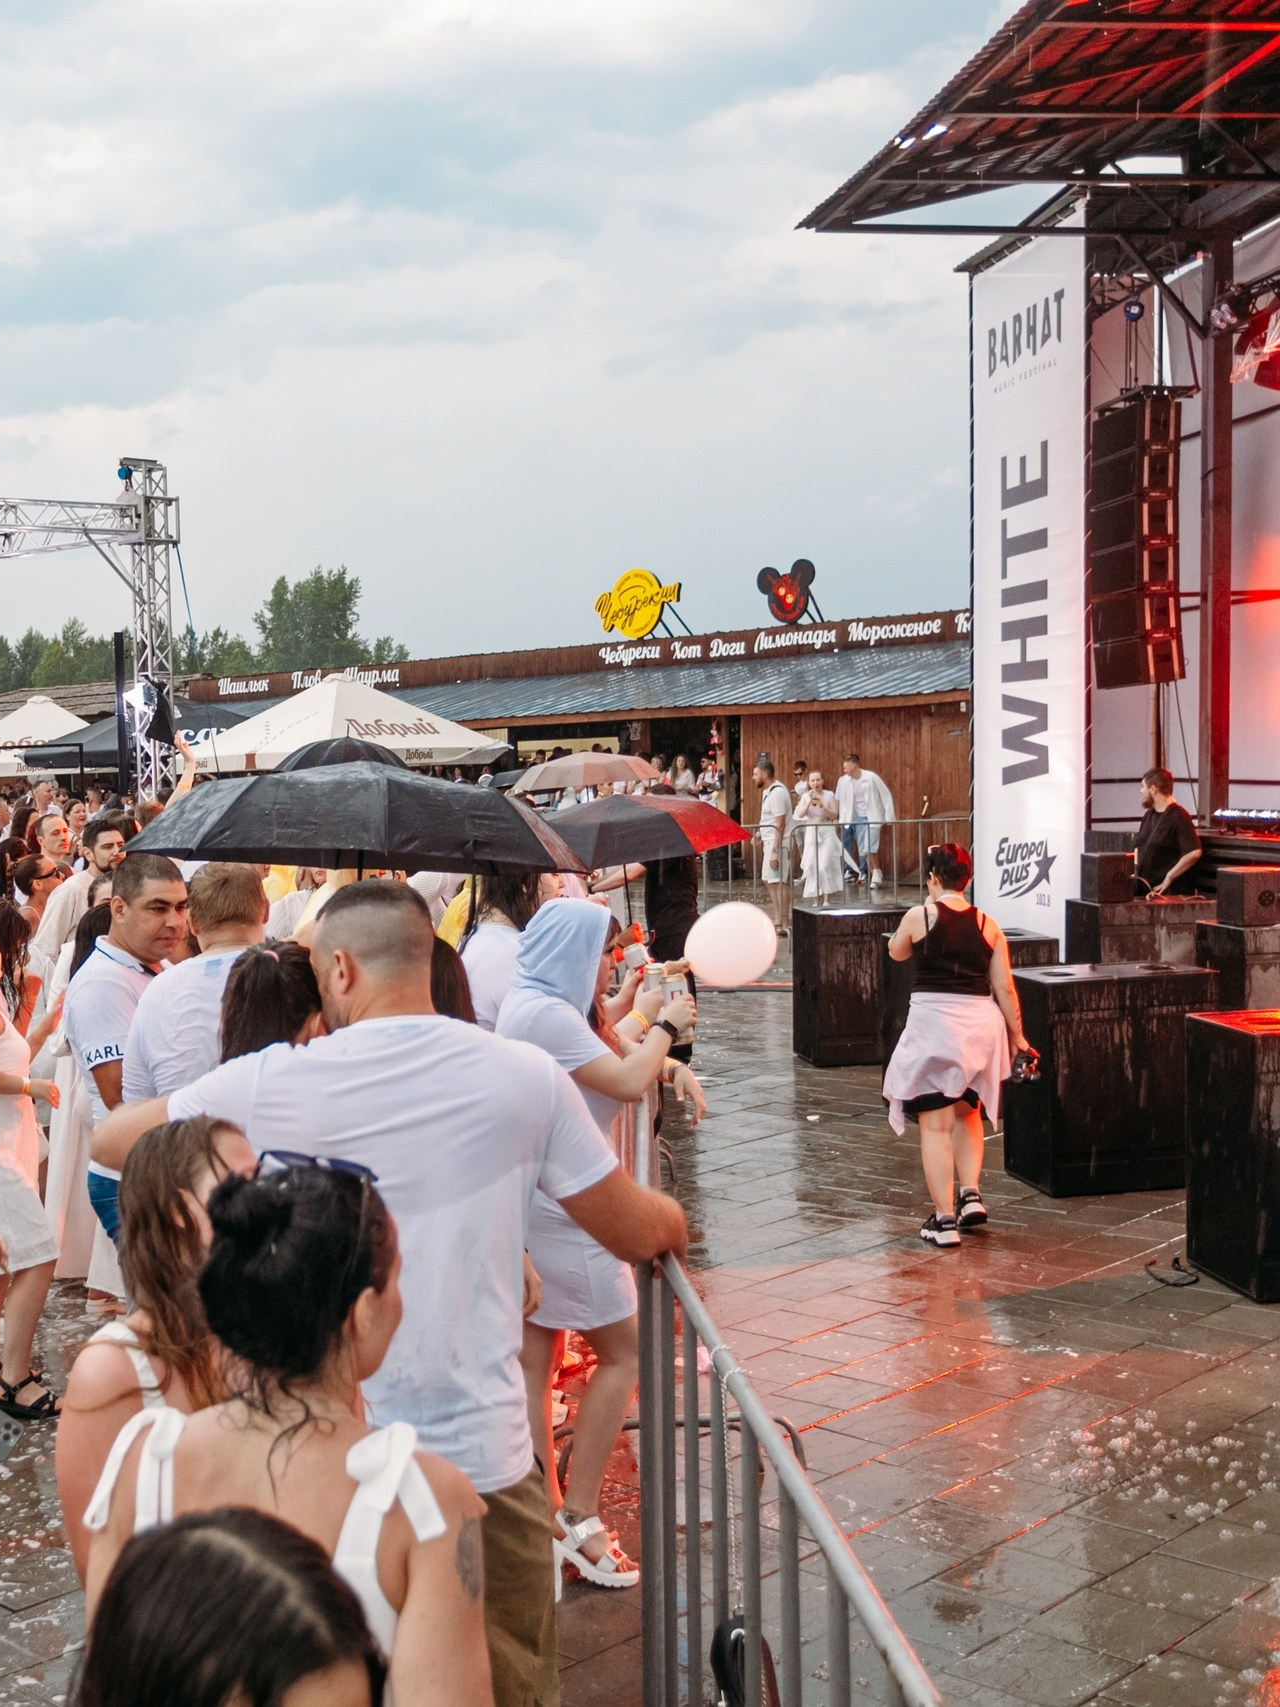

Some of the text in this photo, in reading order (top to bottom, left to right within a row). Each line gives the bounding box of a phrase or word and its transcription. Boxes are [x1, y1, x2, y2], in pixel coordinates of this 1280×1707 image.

[988, 288, 1065, 379] BARHAT
[993, 358, 1057, 393] MUSIC FESTIVAL
[1001, 440, 1049, 786] WHITE
[599, 645, 660, 667] Чебуреки
[670, 641, 702, 660] Хот
[709, 638, 745, 658] Доги
[754, 629, 836, 654] Лимонады
[847, 618, 942, 646] Мороженое
[218, 677, 270, 696] Шашлык
[291, 669, 321, 690] Плов
[345, 718, 440, 738] Добрый
[405, 748, 434, 761] Добрый
[995, 837, 1044, 868] Europa
[1035, 893, 1051, 908] 103.8
[86, 1044, 124, 1065] KARL
